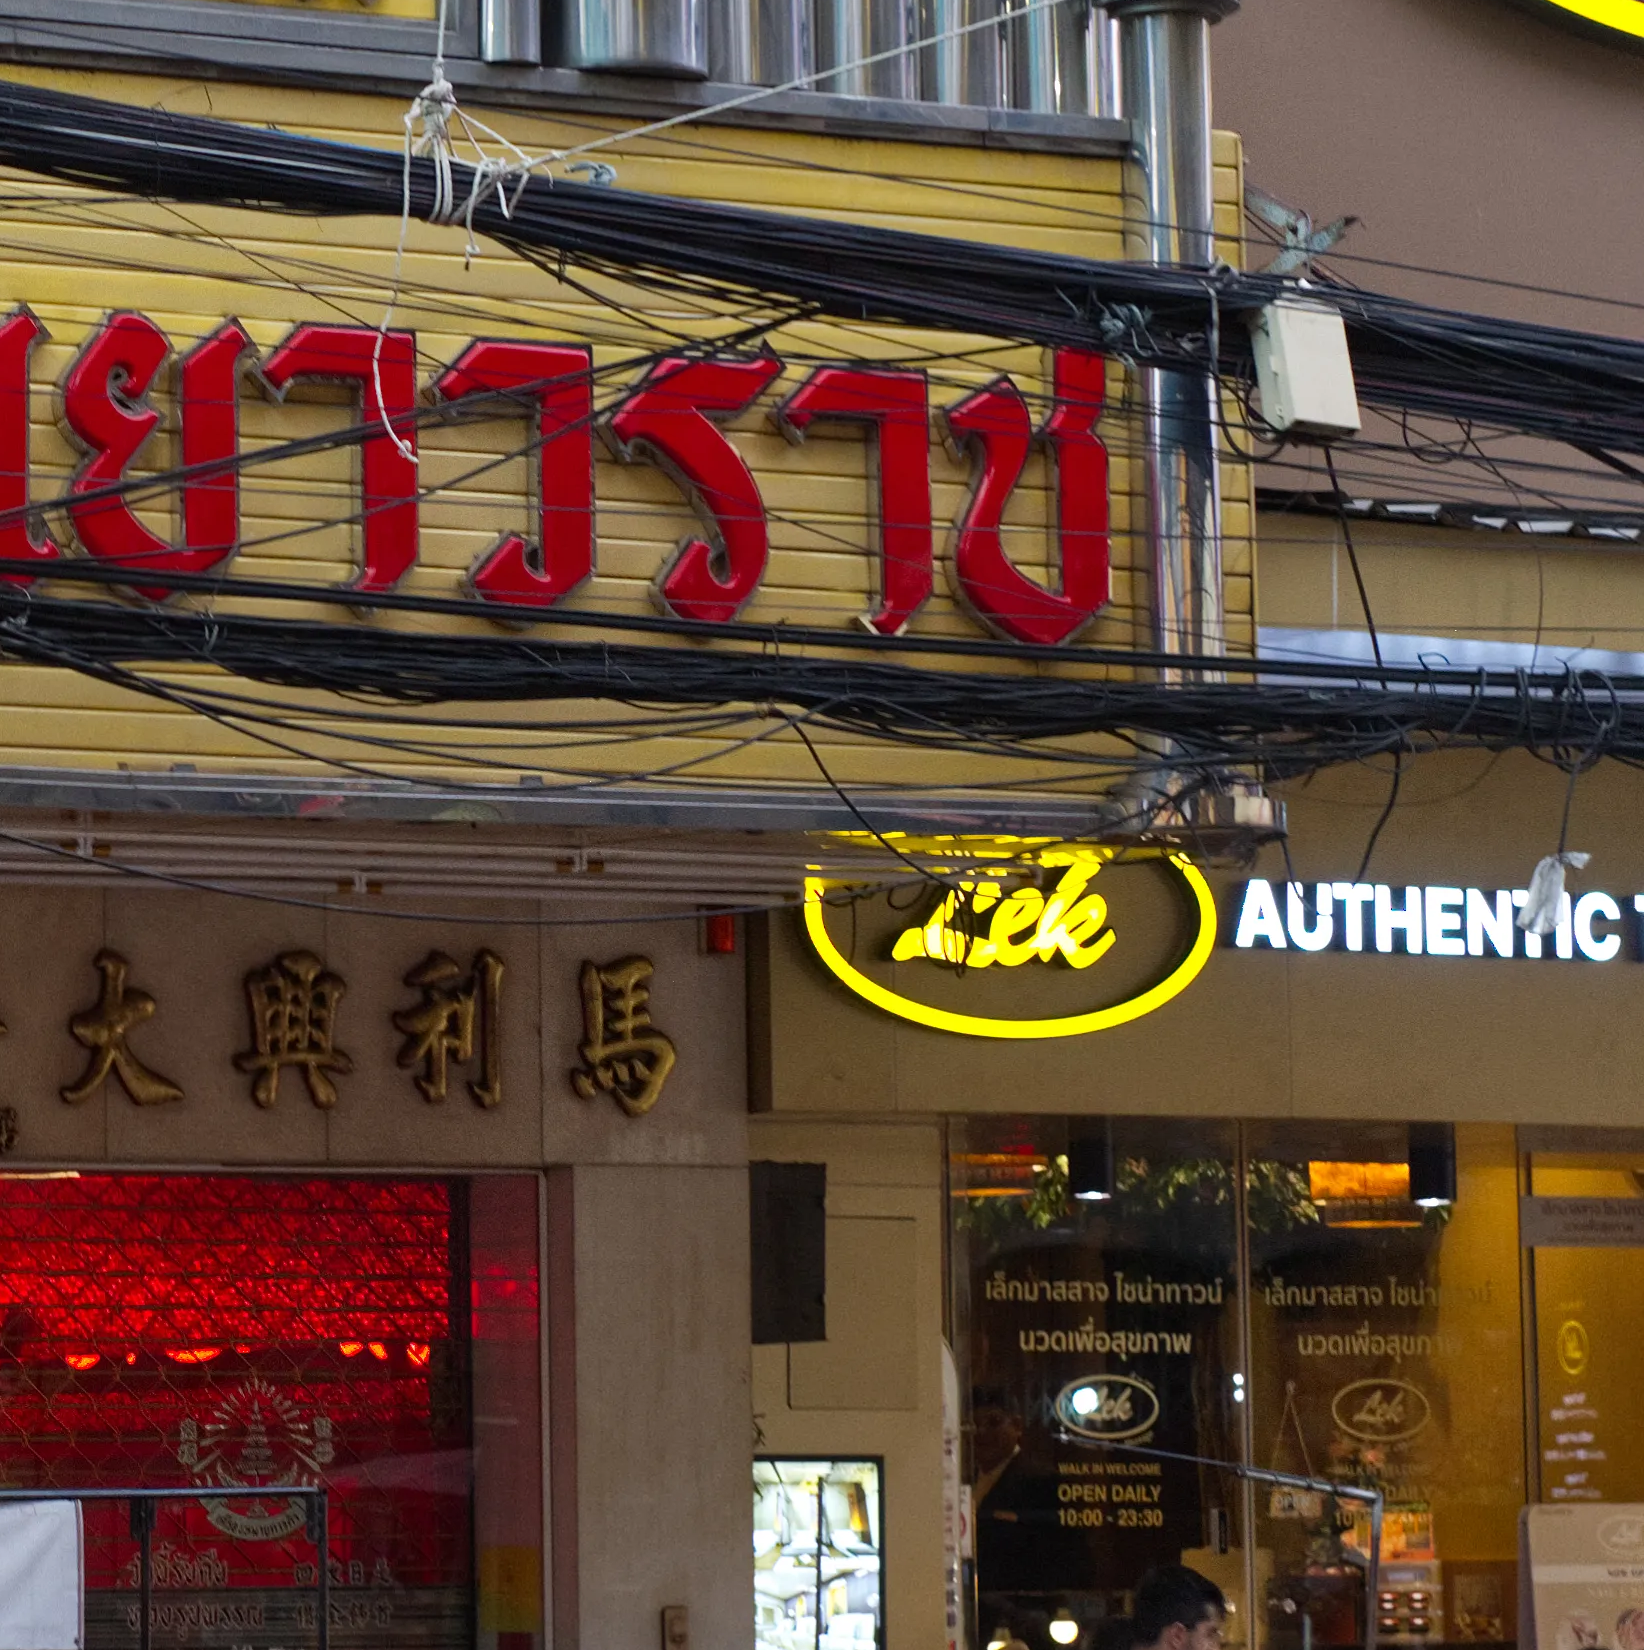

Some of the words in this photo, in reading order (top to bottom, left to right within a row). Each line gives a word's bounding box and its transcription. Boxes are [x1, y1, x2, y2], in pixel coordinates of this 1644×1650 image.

[985, 1271, 1109, 1303] เล็กมาสสาจ
[1113, 1269, 1224, 1305] ไชน่าทาวน์
[1019, 1316, 1192, 1362] นวดเพื่อสุขภาพ
[1057, 1484, 1106, 1503] OPEN
[1111, 1484, 1162, 1503] DAILY
[1058, 1508, 1103, 1527] 10:00
[1117, 1508, 1163, 1527] 23:30
